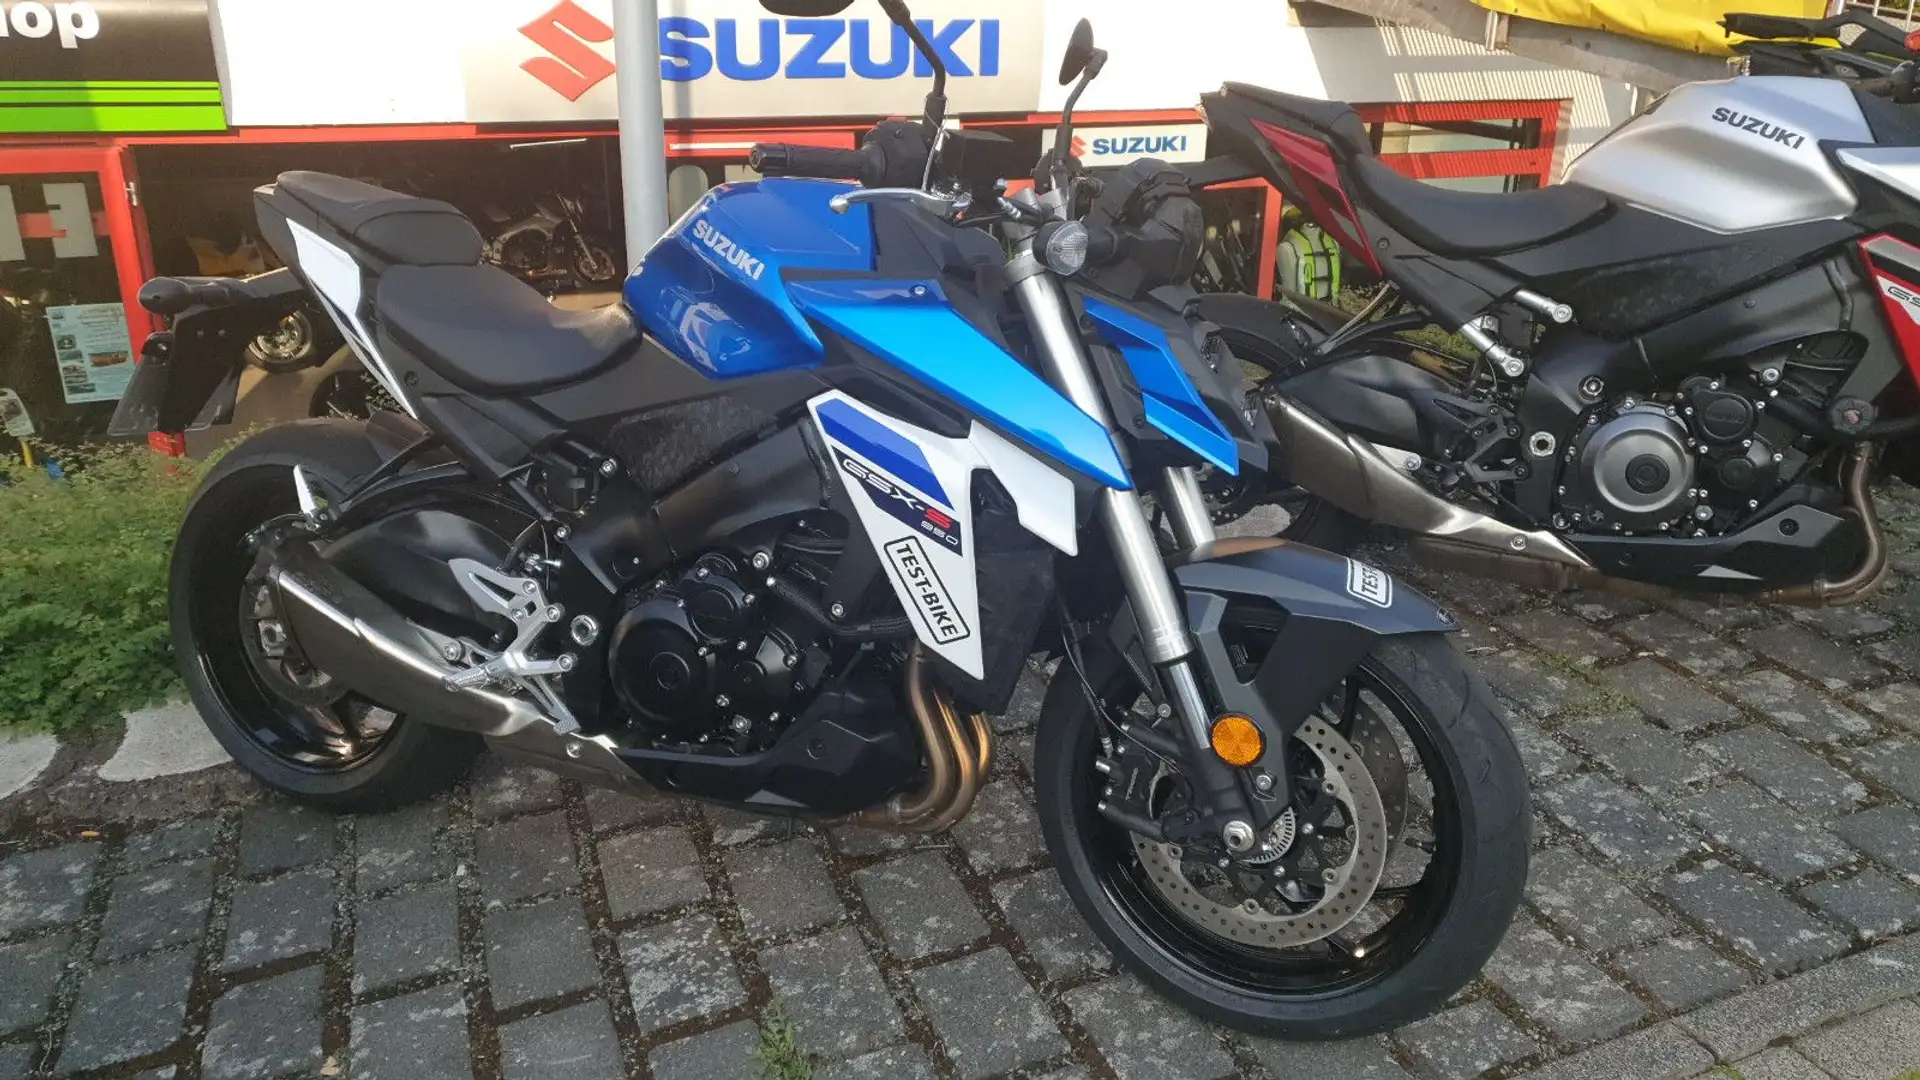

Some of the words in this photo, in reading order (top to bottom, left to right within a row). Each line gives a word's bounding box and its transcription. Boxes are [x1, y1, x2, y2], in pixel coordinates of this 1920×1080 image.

[0, 0, 100, 49] op
[658, 17, 999, 81] SUZUKI
[1092, 135, 1187, 155] SUZUKI
[1711, 107, 1805, 149] SUZUKI
[692, 219, 766, 280] SUZUKI
[842, 458, 953, 529] GSX-S
[920, 520, 959, 546] 950
[896, 543, 960, 638] TEST-BIKE
